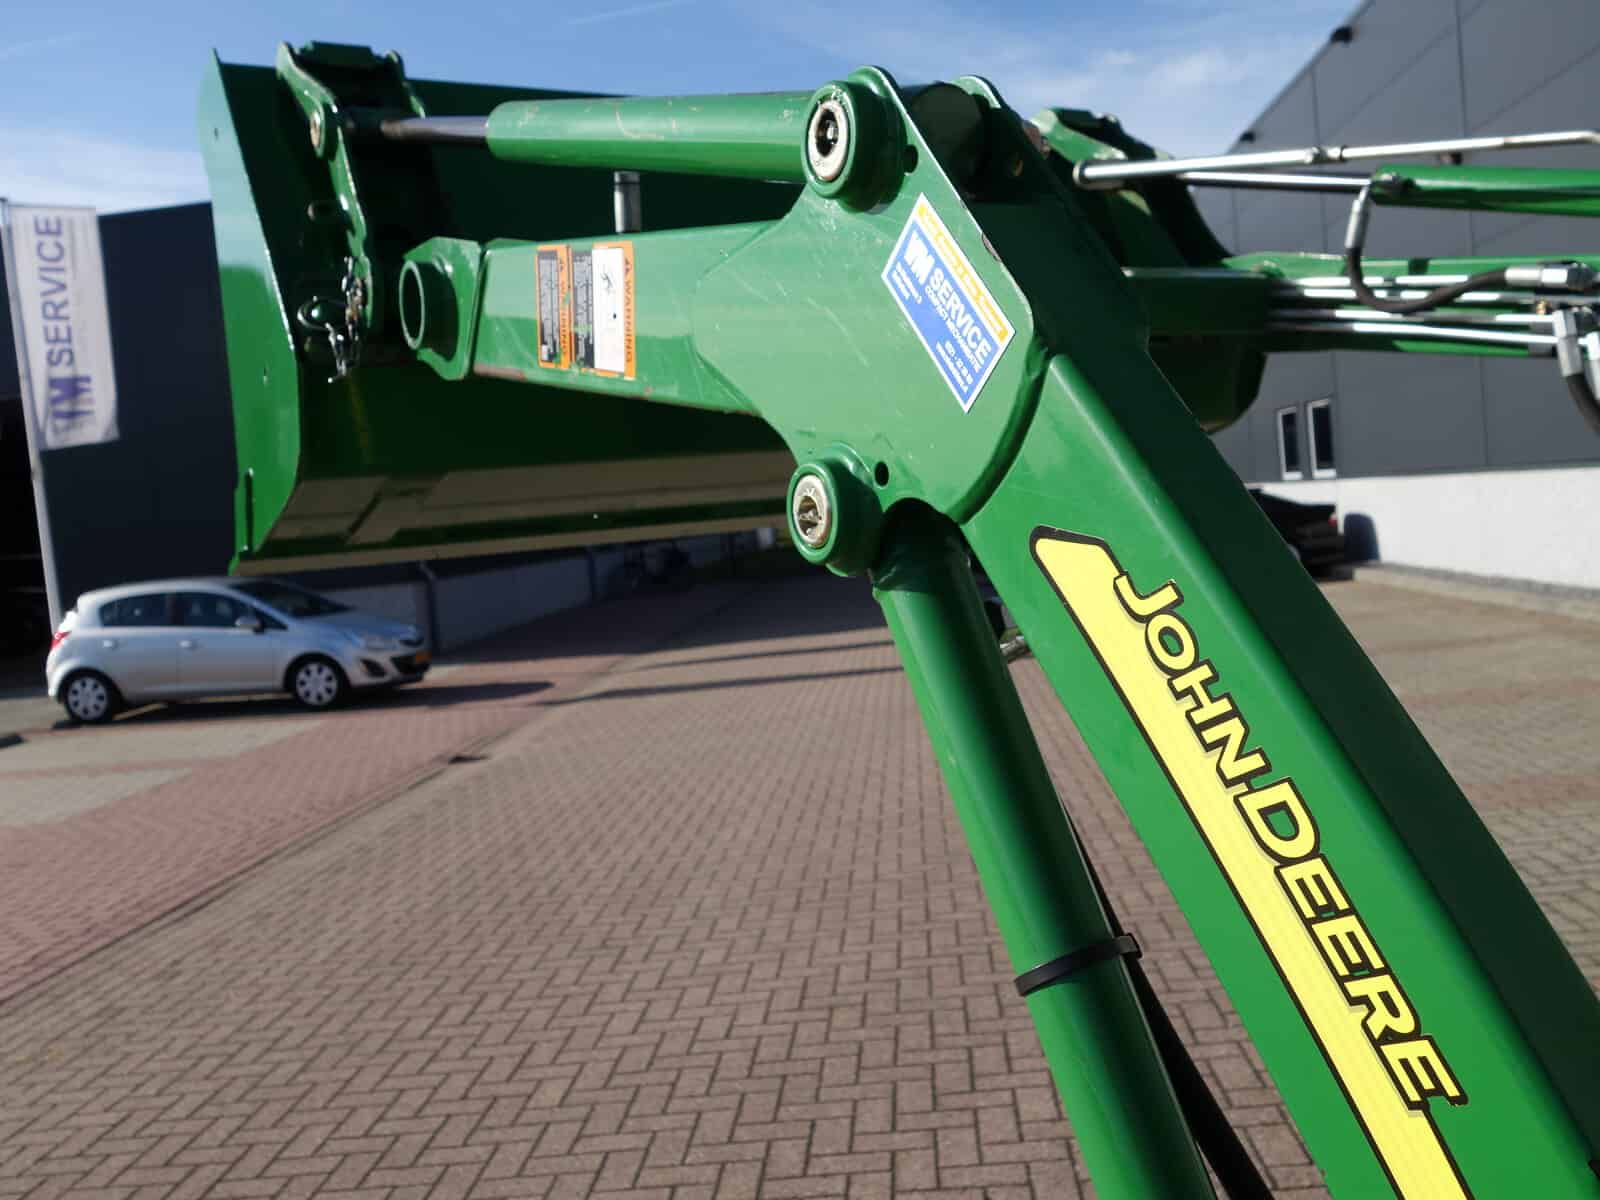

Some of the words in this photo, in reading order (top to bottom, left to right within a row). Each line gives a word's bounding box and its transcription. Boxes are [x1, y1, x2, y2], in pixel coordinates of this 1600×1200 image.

[34, 214, 74, 367] SERVICE
[624, 279, 633, 364] WARNING
[930, 267, 991, 365] SERVICE
[1113, 572, 1272, 790] JOHN
[1233, 777, 1468, 1111] DEERE
